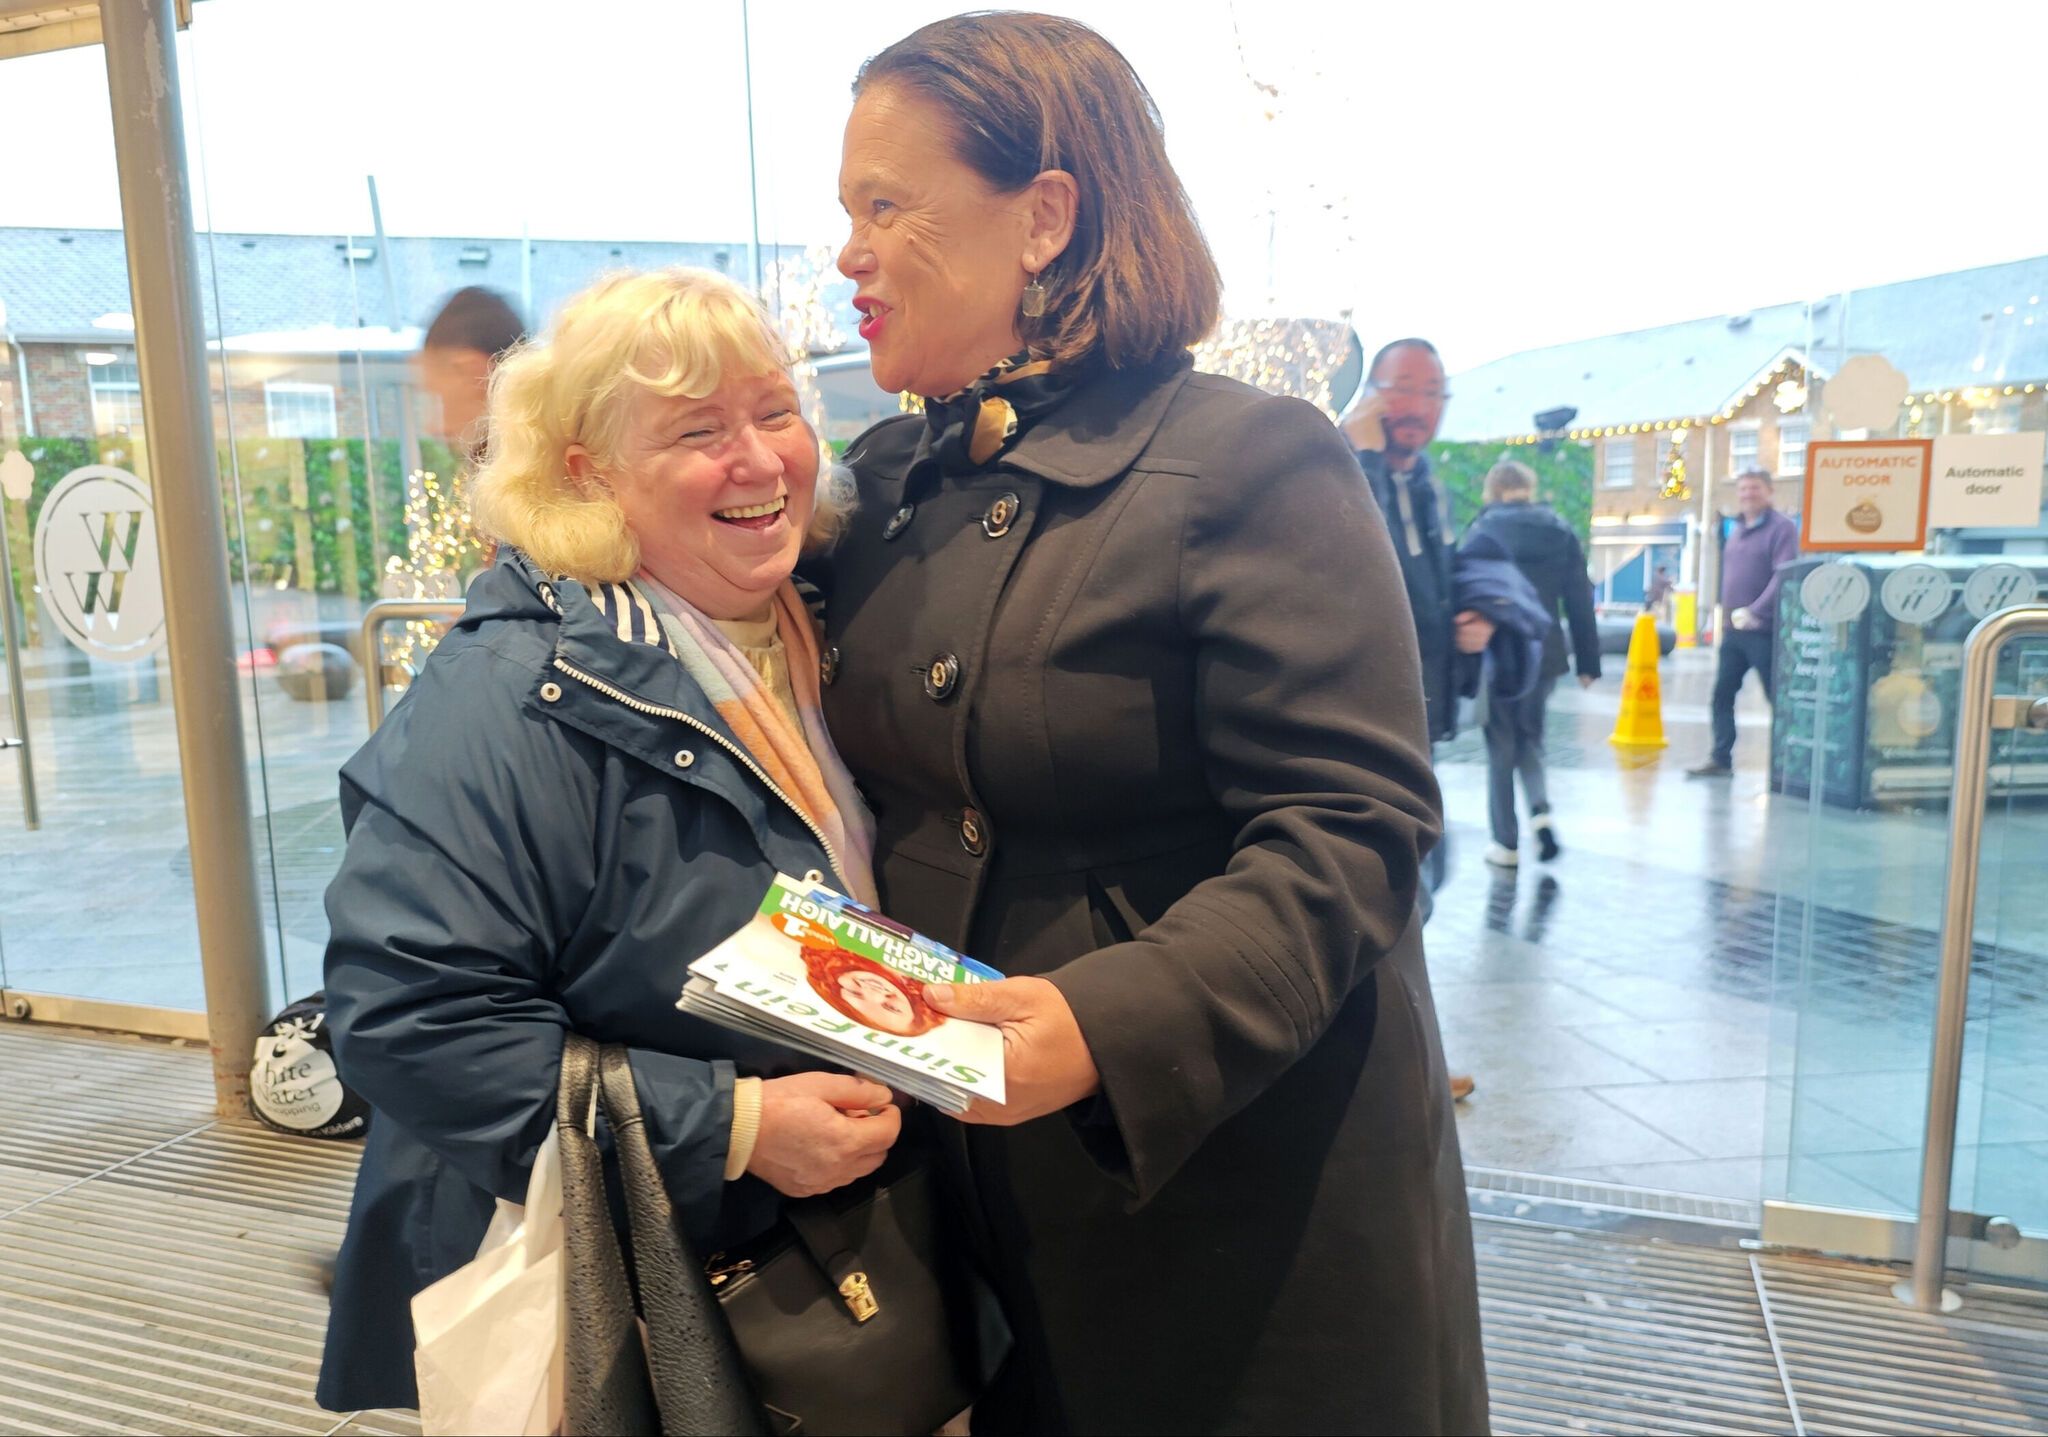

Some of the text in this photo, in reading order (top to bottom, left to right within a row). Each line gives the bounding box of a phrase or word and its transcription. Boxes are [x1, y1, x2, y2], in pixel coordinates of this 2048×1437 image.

[1819, 455, 1918, 469] AUTOMATIC
[1843, 474, 1891, 487] DOOR
[1945, 465, 2025, 479] Automatic
[1964, 483, 2002, 496] door
[779, 890, 956, 982] RAGHALLAIGH
[883, 952, 948, 985] nagh
[735, 980, 987, 1084] Sinn Féin
[265, 1061, 312, 1085] hite
